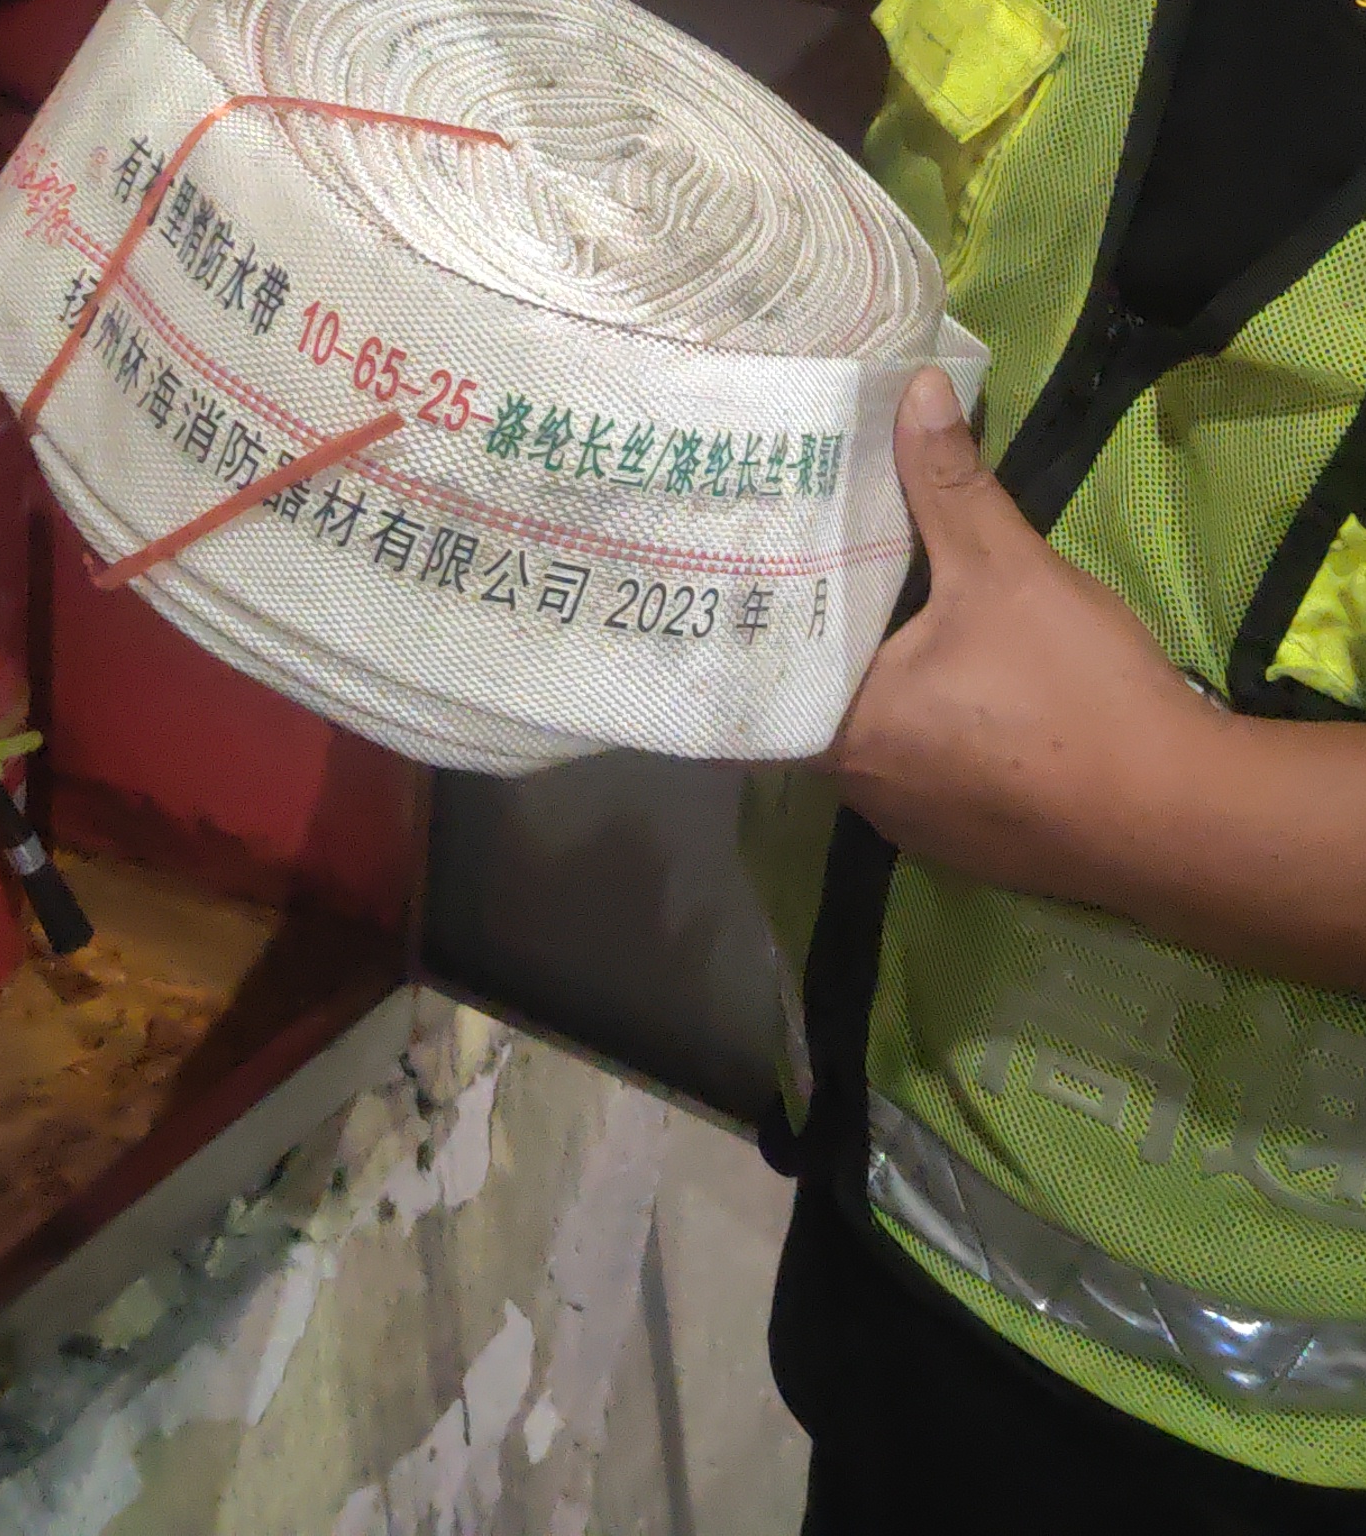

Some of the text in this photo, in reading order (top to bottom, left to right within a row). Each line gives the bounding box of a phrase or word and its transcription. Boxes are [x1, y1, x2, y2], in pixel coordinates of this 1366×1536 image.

[604, 577, 720, 639] 2023
[735, 582, 774, 645] 年
[808, 577, 828, 640] 月
